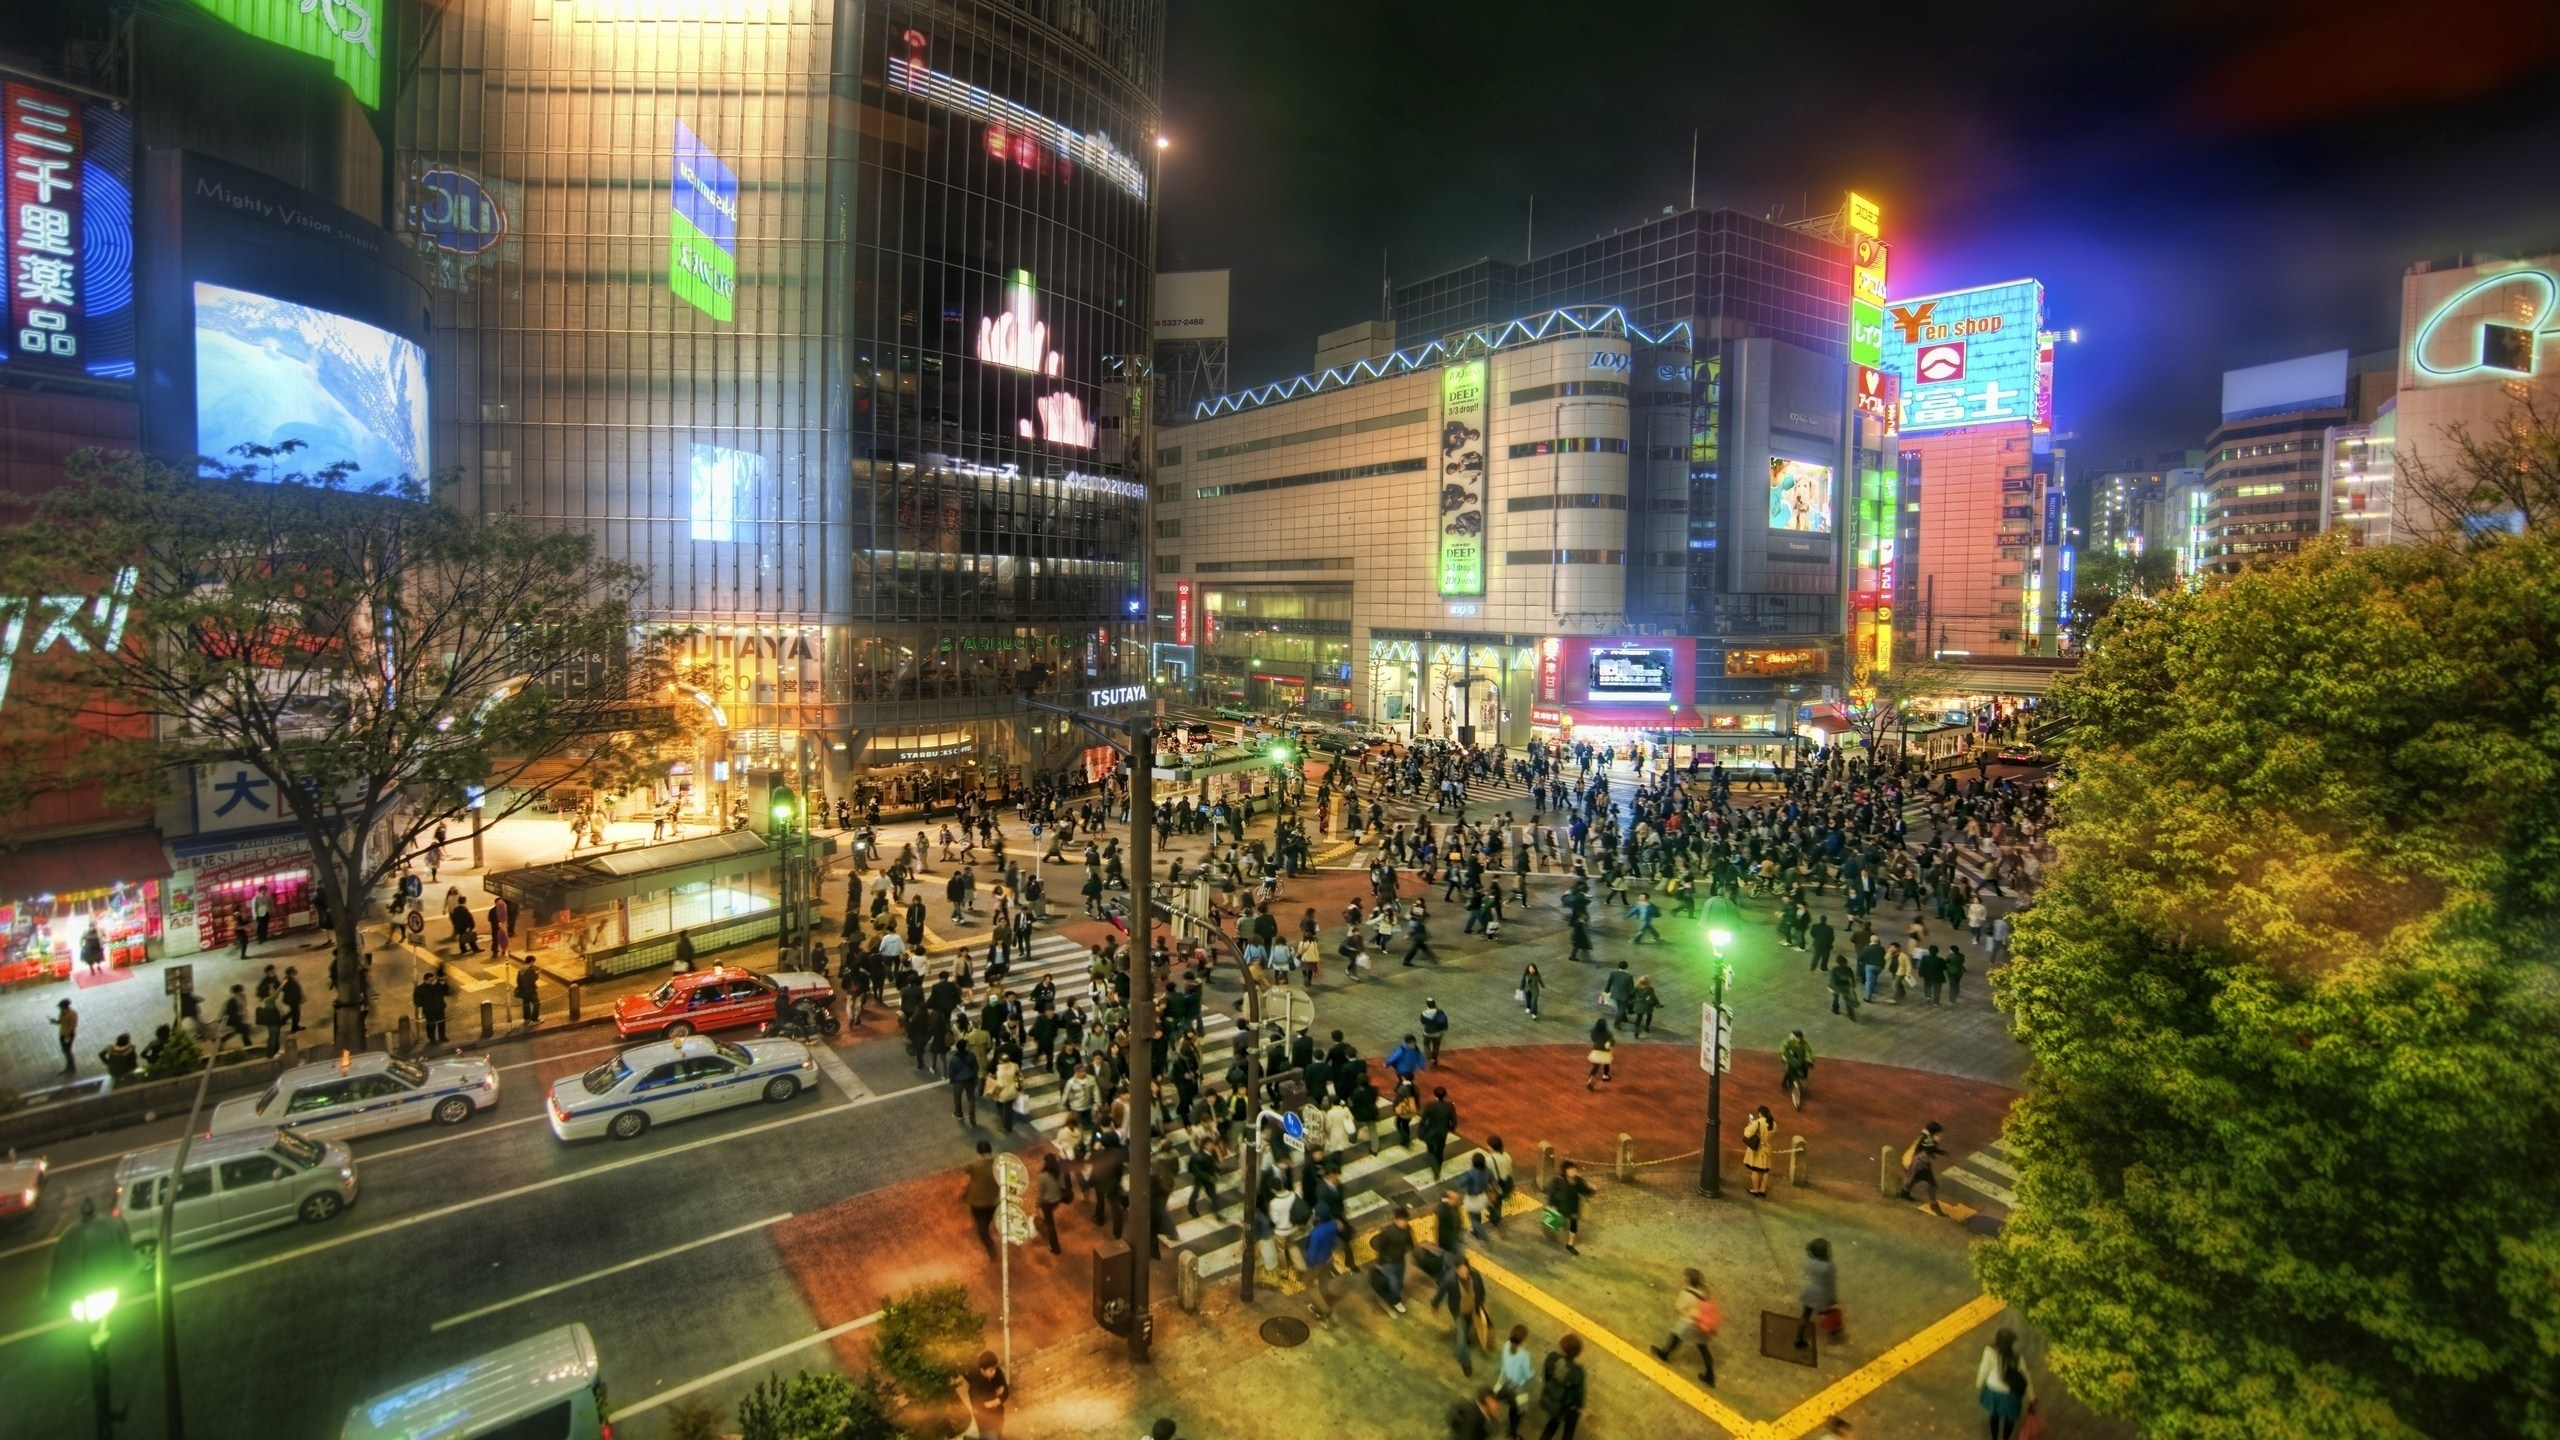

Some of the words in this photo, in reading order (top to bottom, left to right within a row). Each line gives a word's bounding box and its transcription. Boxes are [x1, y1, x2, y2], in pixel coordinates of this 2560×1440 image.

[196, 177, 273, 216] Mighty
[278, 205, 331, 234] Vision
[338, 230, 380, 254] SHIBUYA
[14, 98, 76, 356] 三千里薬品
[1860, 272, 1887, 300] アコム
[1855, 318, 1882, 349] レイク
[1953, 315, 2003, 337] shop
[1449, 387, 1479, 402] DEEP
[1858, 392, 1884, 414] アイフル
[1449, 406, 1459, 416] 3/3
[1460, 403, 1479, 413] drop!!
[1446, 548, 1476, 558] DEEP
[1881, 567, 1892, 589] アコム
[591, 653, 602, 663] &
[1091, 685, 1147, 707] TSUTAYA
[953, 745, 972, 755] CFFEE
[235, 836, 295, 850] TAISEIDO
